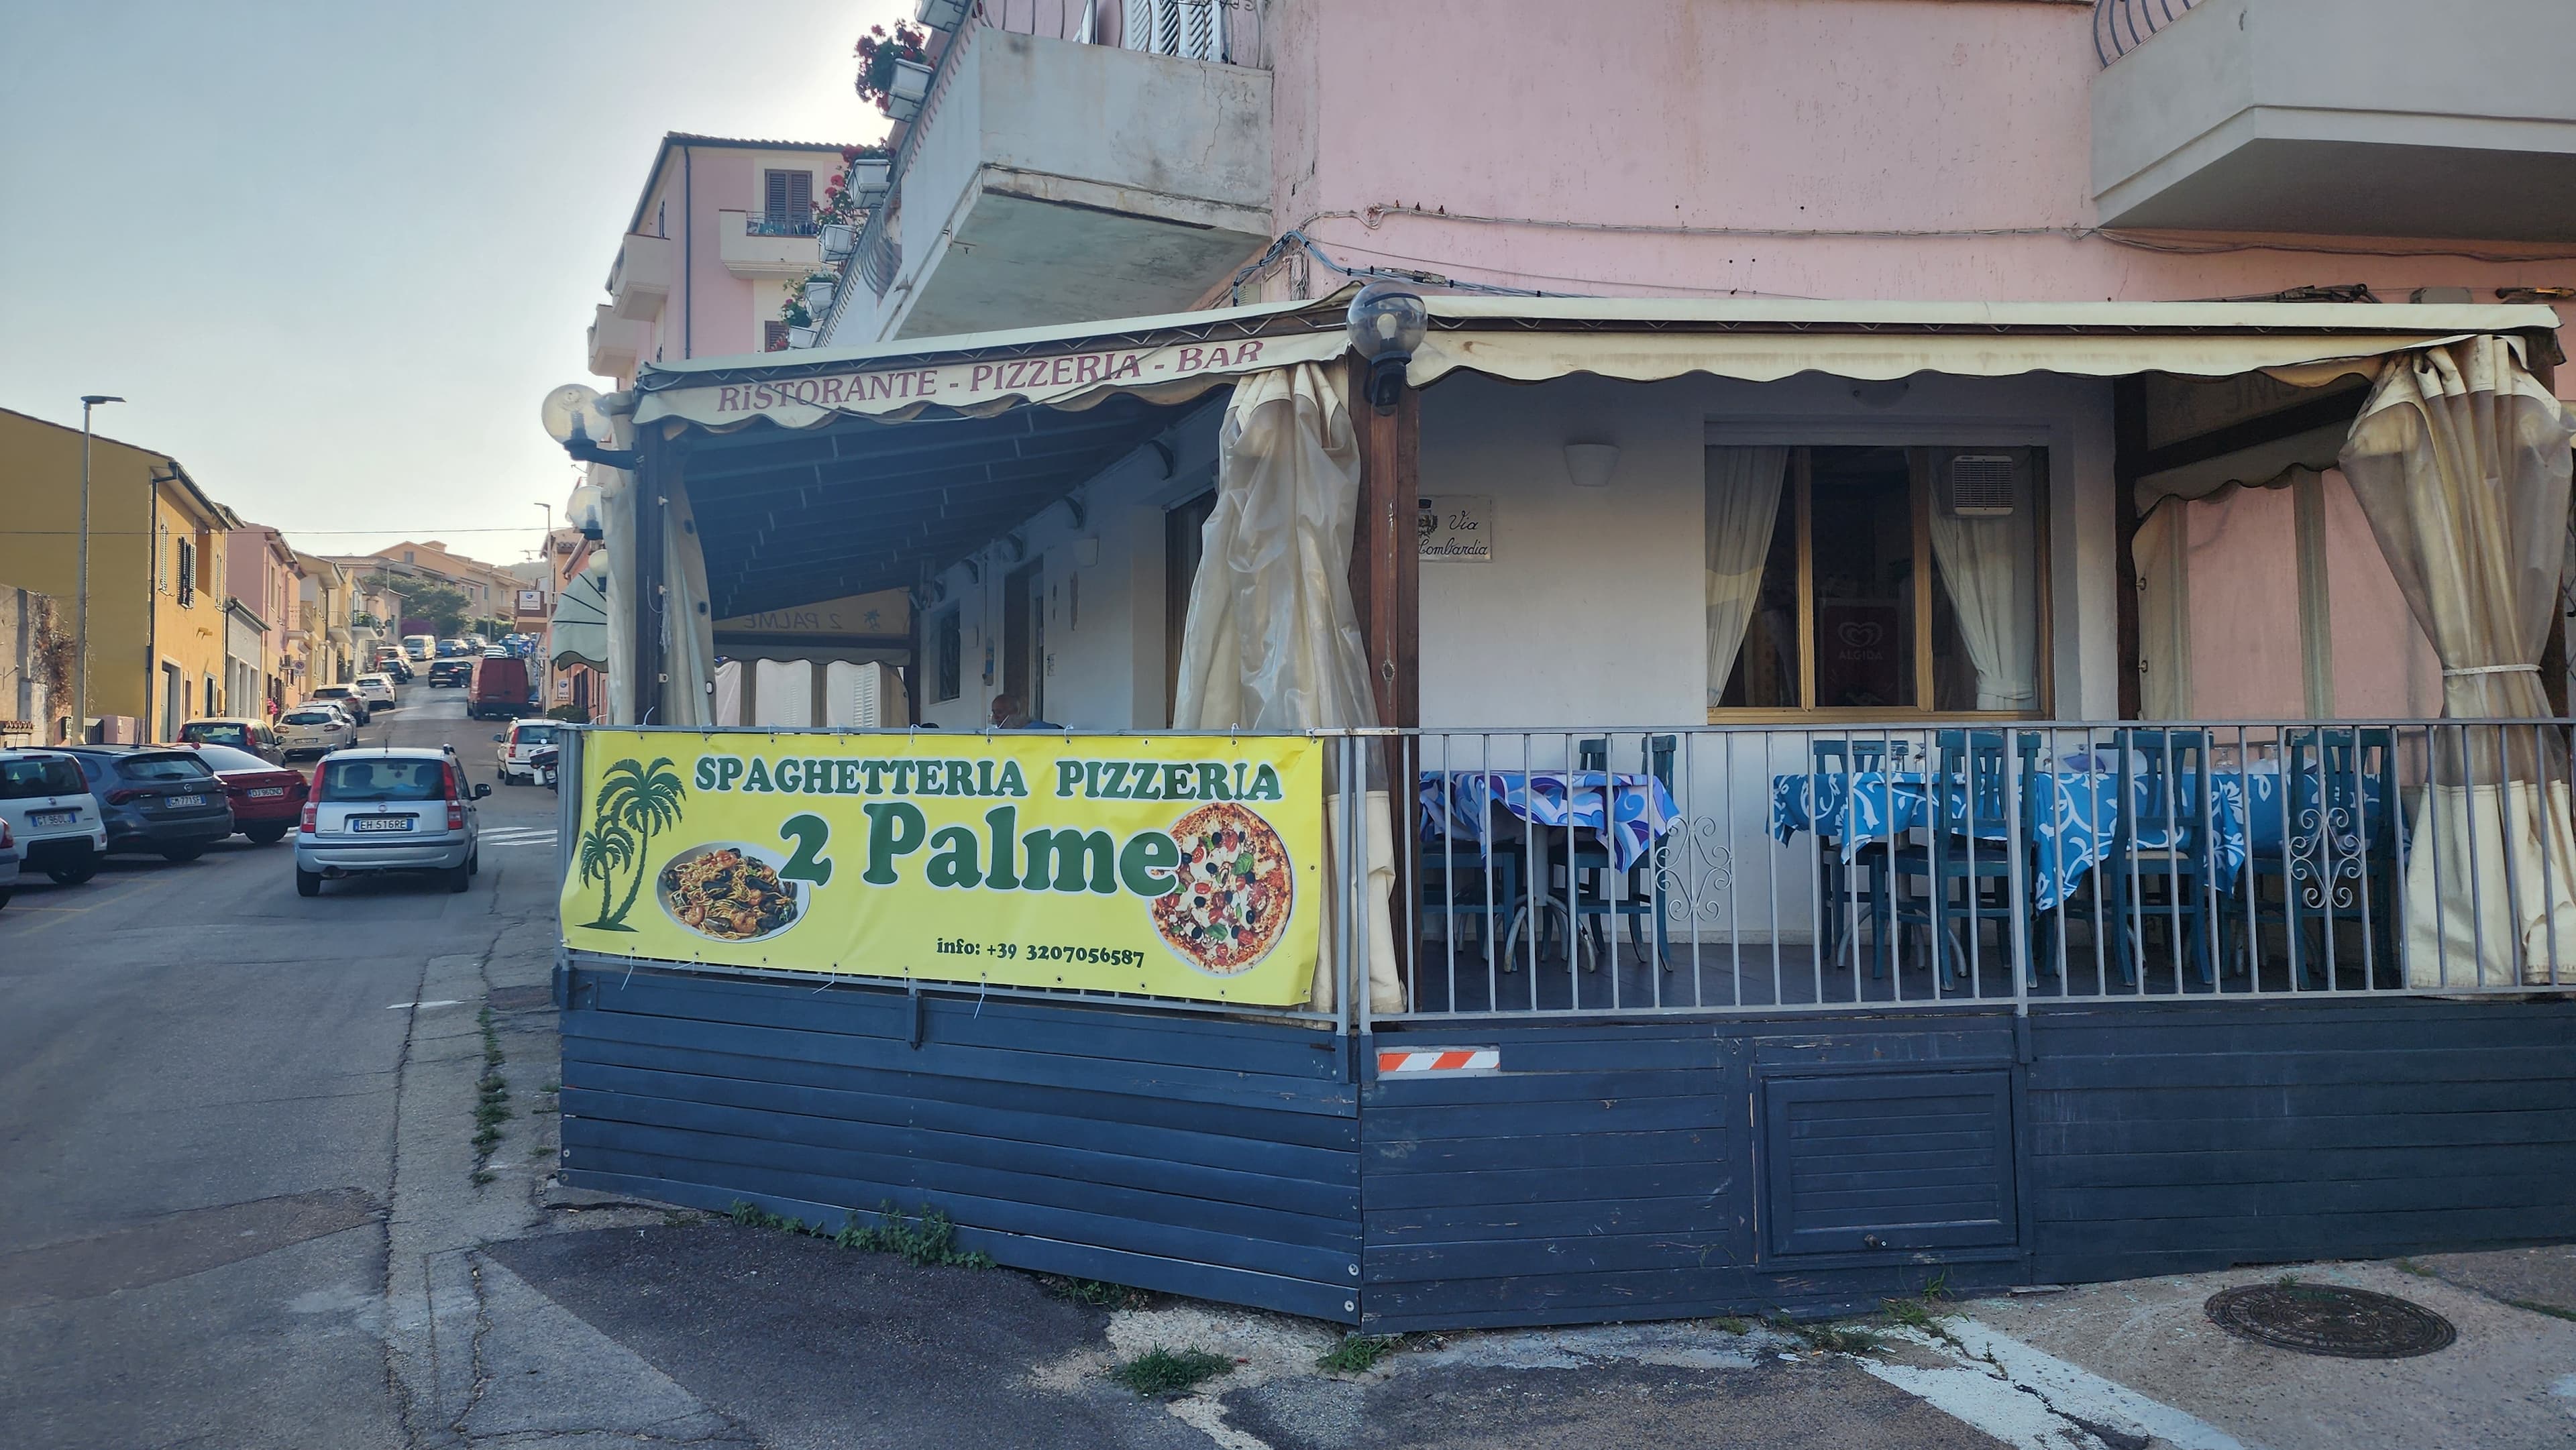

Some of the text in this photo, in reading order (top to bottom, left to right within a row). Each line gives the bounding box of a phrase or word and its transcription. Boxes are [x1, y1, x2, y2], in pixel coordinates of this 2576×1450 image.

[970, 353, 1141, 392] PIZZERIA
[1175, 340, 1264, 373] BAR
[1449, 510, 1479, 530] Via
[1419, 537, 1488, 555] Lombardia
[1838, 649, 1883, 661] ALGIDA
[696, 757, 1283, 801] SPAGHETTERIA PIZZERIA
[360, 820, 406, 830] EH 516RE
[778, 802, 1180, 897] 2 Palme
[936, 938, 1144, 968] info: +39 3207056587
